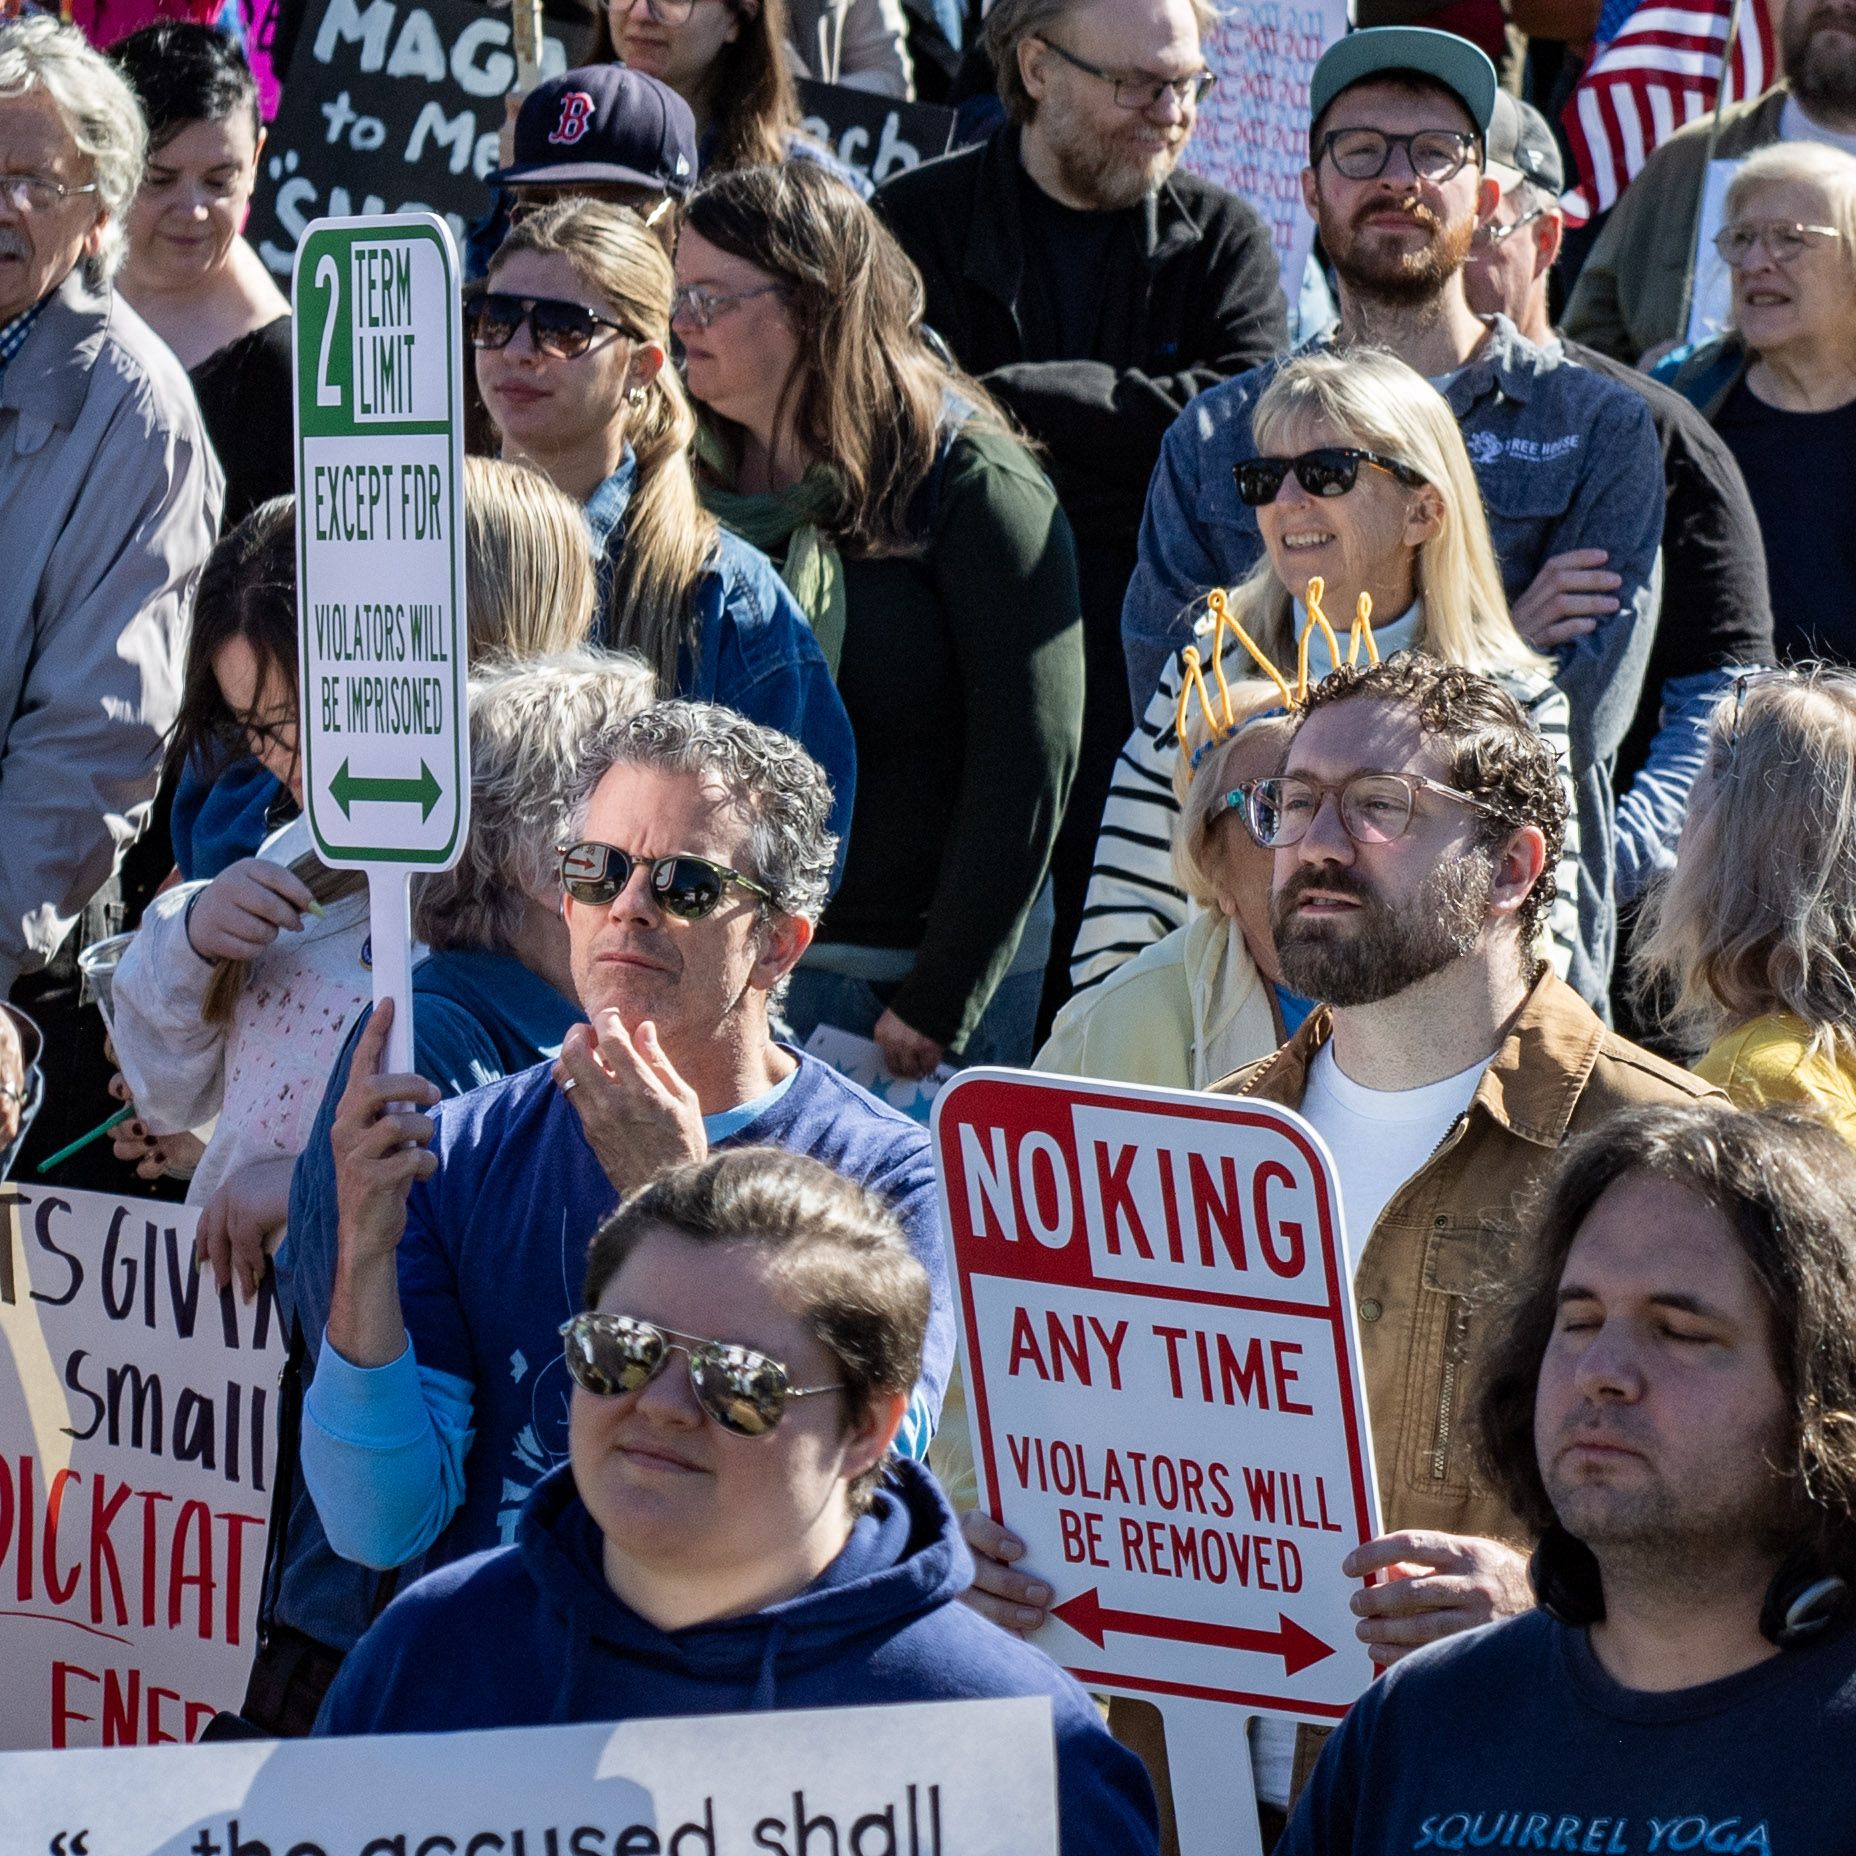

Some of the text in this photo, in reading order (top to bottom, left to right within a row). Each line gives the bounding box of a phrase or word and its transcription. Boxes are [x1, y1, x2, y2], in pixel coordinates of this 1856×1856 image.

[321, 90, 386, 150] to
[548, 91, 595, 145] B
[314, 247, 413, 408] 2 TERM
[359, 335, 417, 416] LIMIT
[1505, 434, 1580, 456] TREE HOUSE
[315, 464, 442, 543] EXCEPT FDR
[314, 603, 449, 664] VIOLATORS WILL
[321, 675, 443, 737] BE IMPRISONED
[958, 1121, 1306, 1281] NO KING
[1008, 1305, 1315, 1416] ANY TIME
[59, 1348, 267, 1492] small
[1006, 1433, 1343, 1533] VIOLATORS WILL
[1059, 1508, 1304, 1595] BE REMOVED
[753, 1783, 943, 1856] shall
[1413, 1811, 1773, 1856] SQUIRREL YOGA
